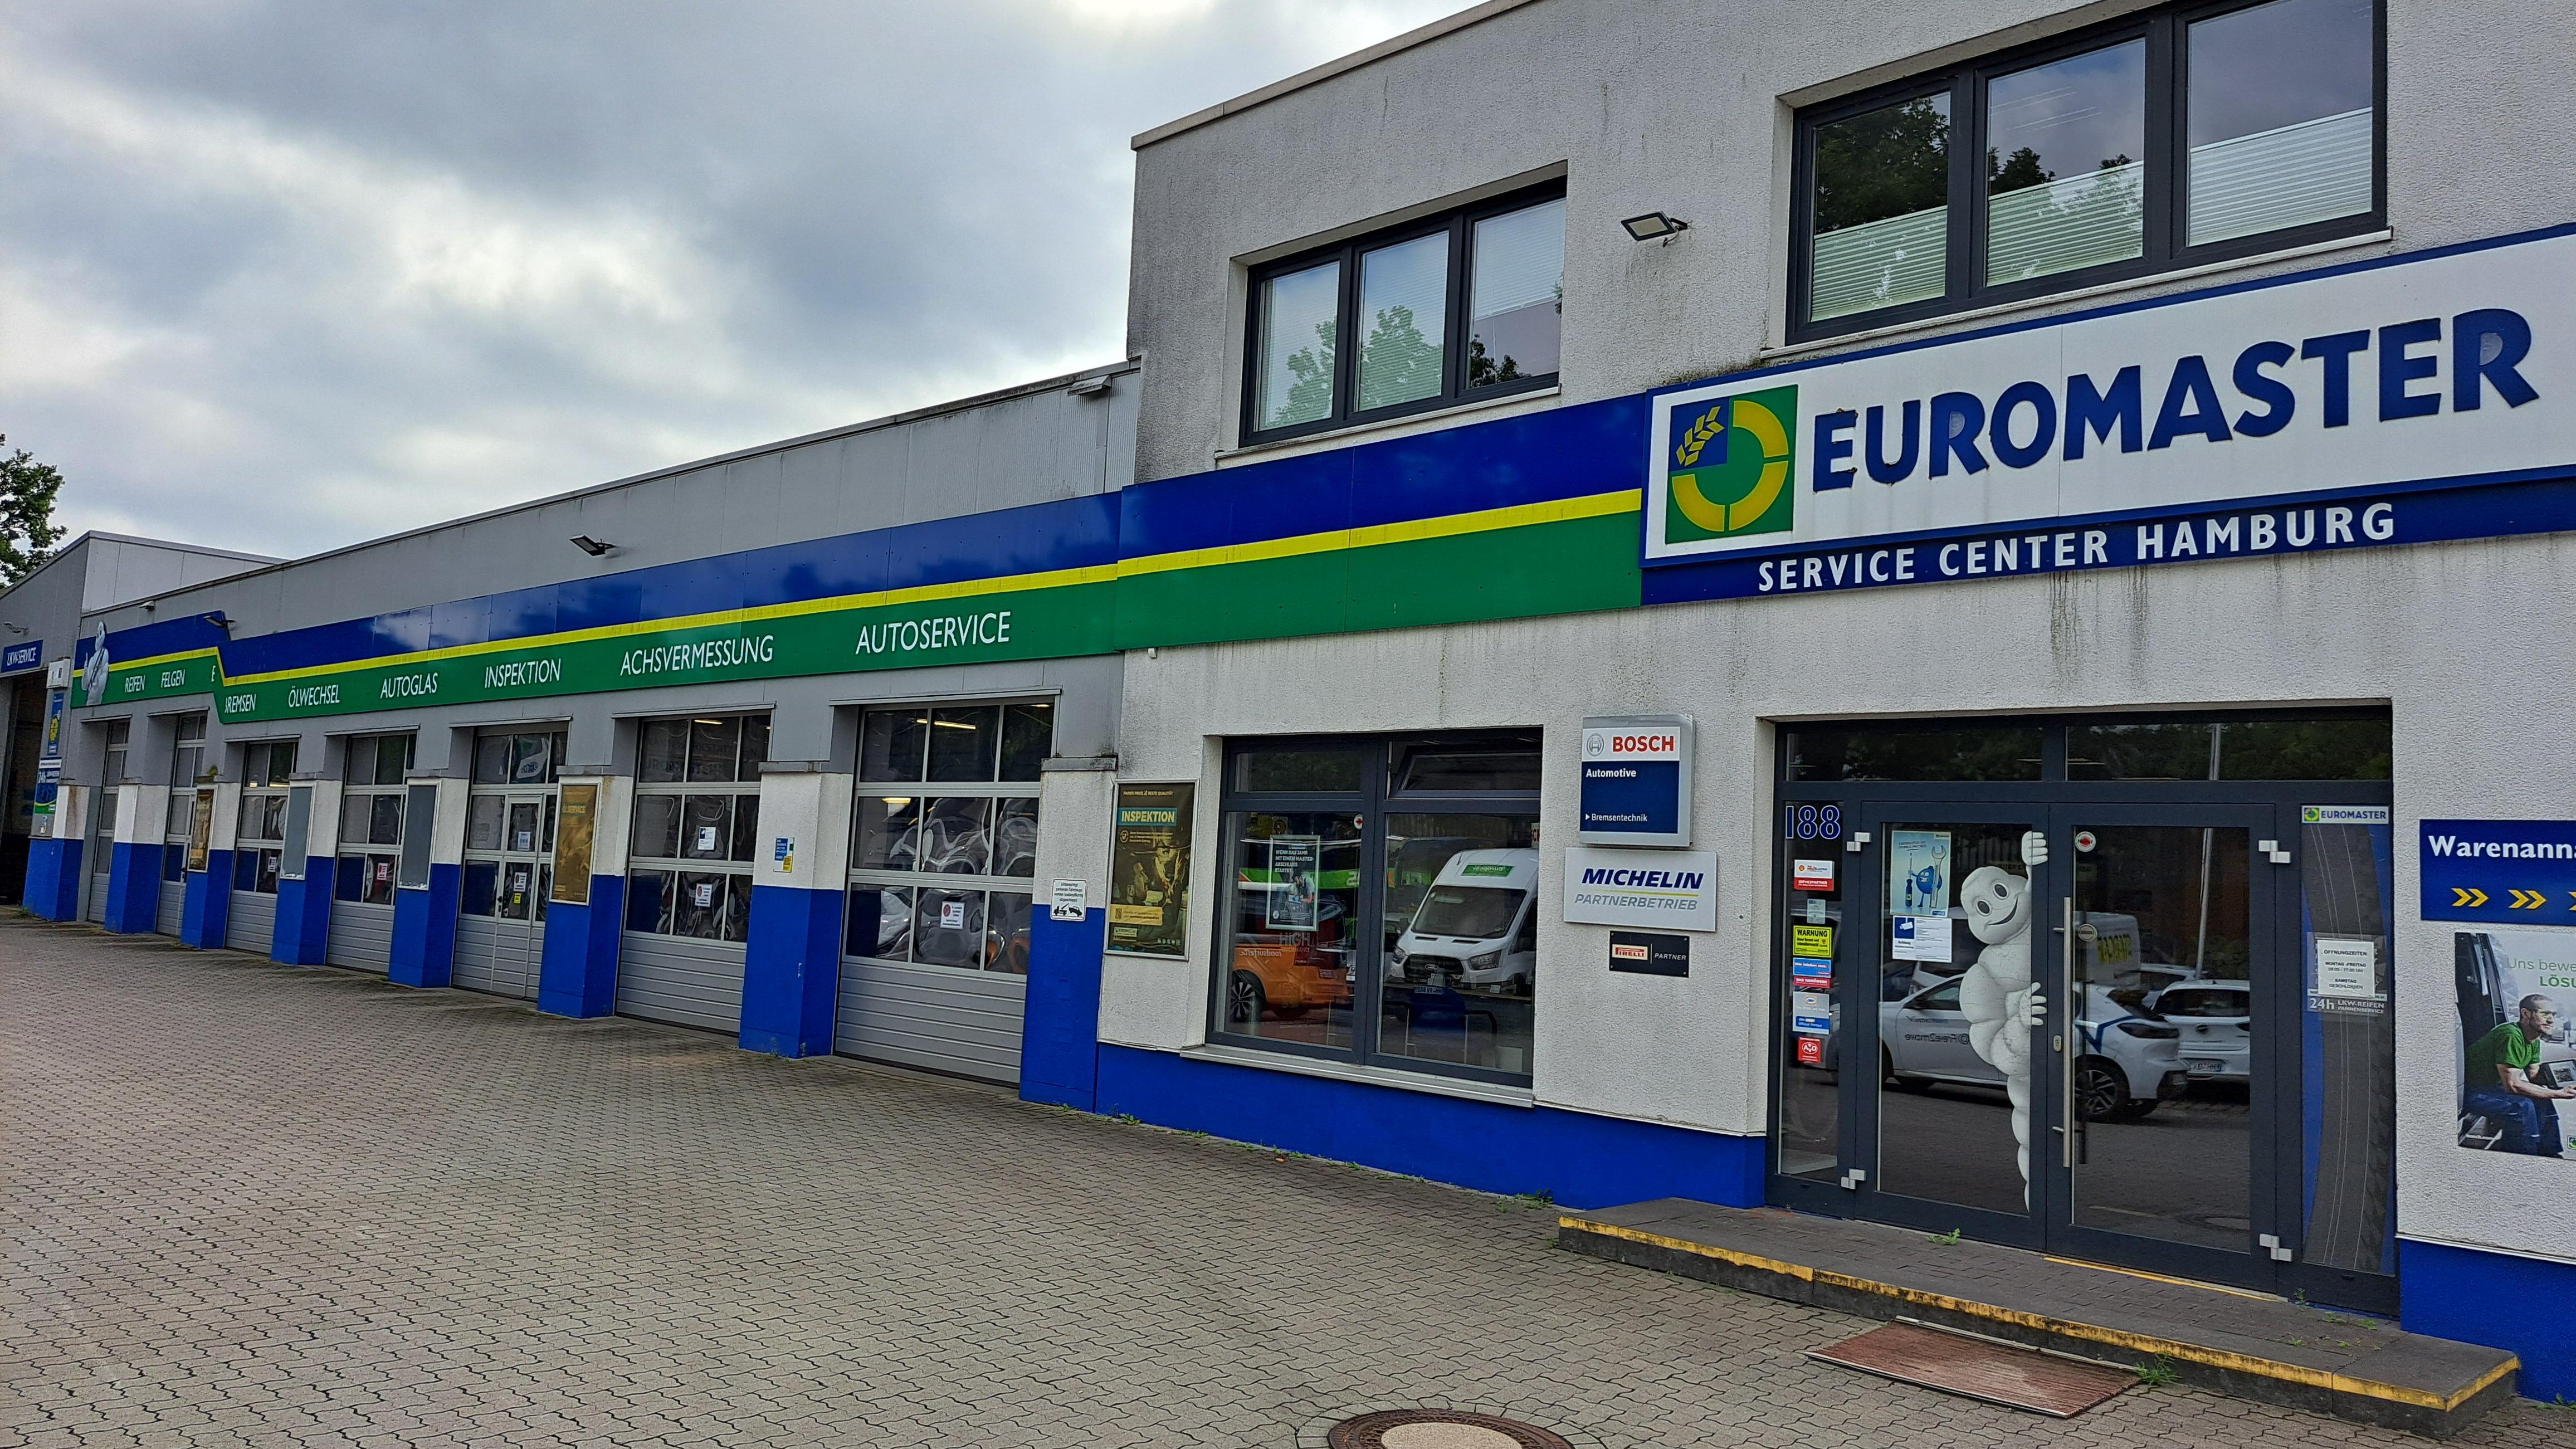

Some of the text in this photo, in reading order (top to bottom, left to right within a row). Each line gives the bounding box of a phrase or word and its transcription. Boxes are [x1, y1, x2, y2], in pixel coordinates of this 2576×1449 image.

[1813, 308, 2540, 494] EUROMASTER
[1759, 502, 2394, 592] SERVICE CENTER HAMBURG
[856, 611, 1011, 655] AUTOSERVICE
[620, 635, 774, 676] ACHSVERMESSUNG
[161, 669, 186, 688] FELGEN
[485, 658, 561, 688] INSPEKTION
[125, 675, 145, 692] REIFEN
[380, 673, 438, 699] AUTOGLAS
[287, 685, 340, 708] ÖLWECHSEL
[1613, 735, 1674, 752] BOSCH
[1586, 768, 1637, 777] Automotive
[1121, 811, 1175, 823] INSPEKTION
[1592, 813, 1647, 822] Bremsentechnik
[1785, 805, 1841, 839] 188
[2321, 811, 2387, 819] EUROMASTER
[2428, 835, 2576, 859] Warenann
[1582, 869, 1704, 889] MICHELIN
[1575, 894, 1698, 910] PARTNERBETRIEB
[1615, 947, 1645, 957] PIRELLI
[2508, 958, 2534, 970] Uns
[2309, 998, 2384, 1010] 24h LKW-REIFEN
